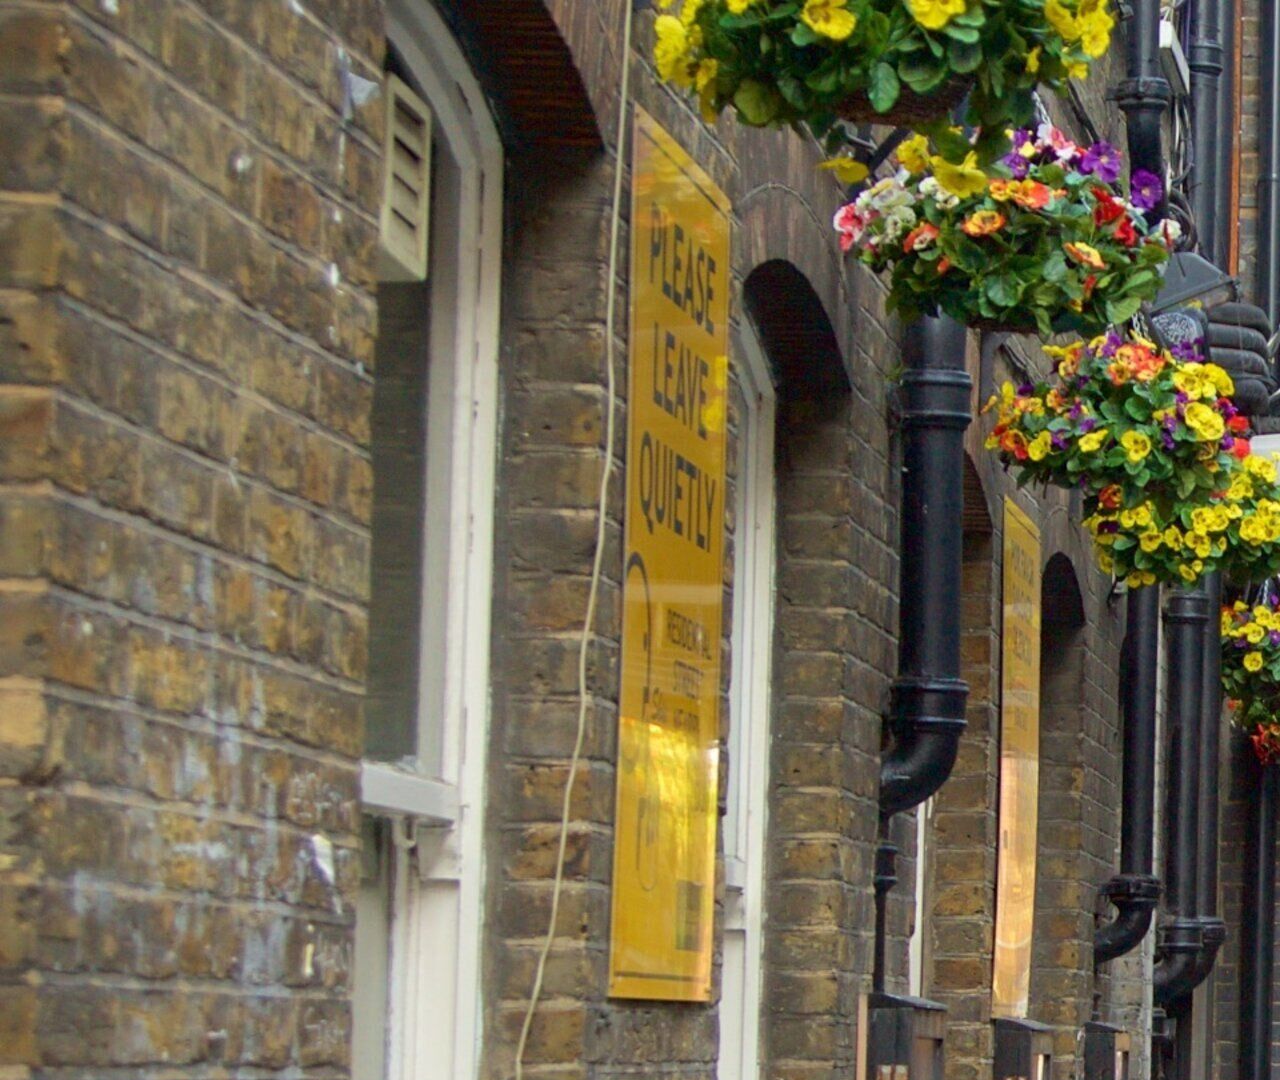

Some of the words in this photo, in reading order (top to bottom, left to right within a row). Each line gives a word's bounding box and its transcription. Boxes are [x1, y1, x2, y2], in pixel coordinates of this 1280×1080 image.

[649, 201, 717, 337] PLEASE
[653, 321, 709, 440] LEAVE
[639, 431, 717, 553] QUIETLY
